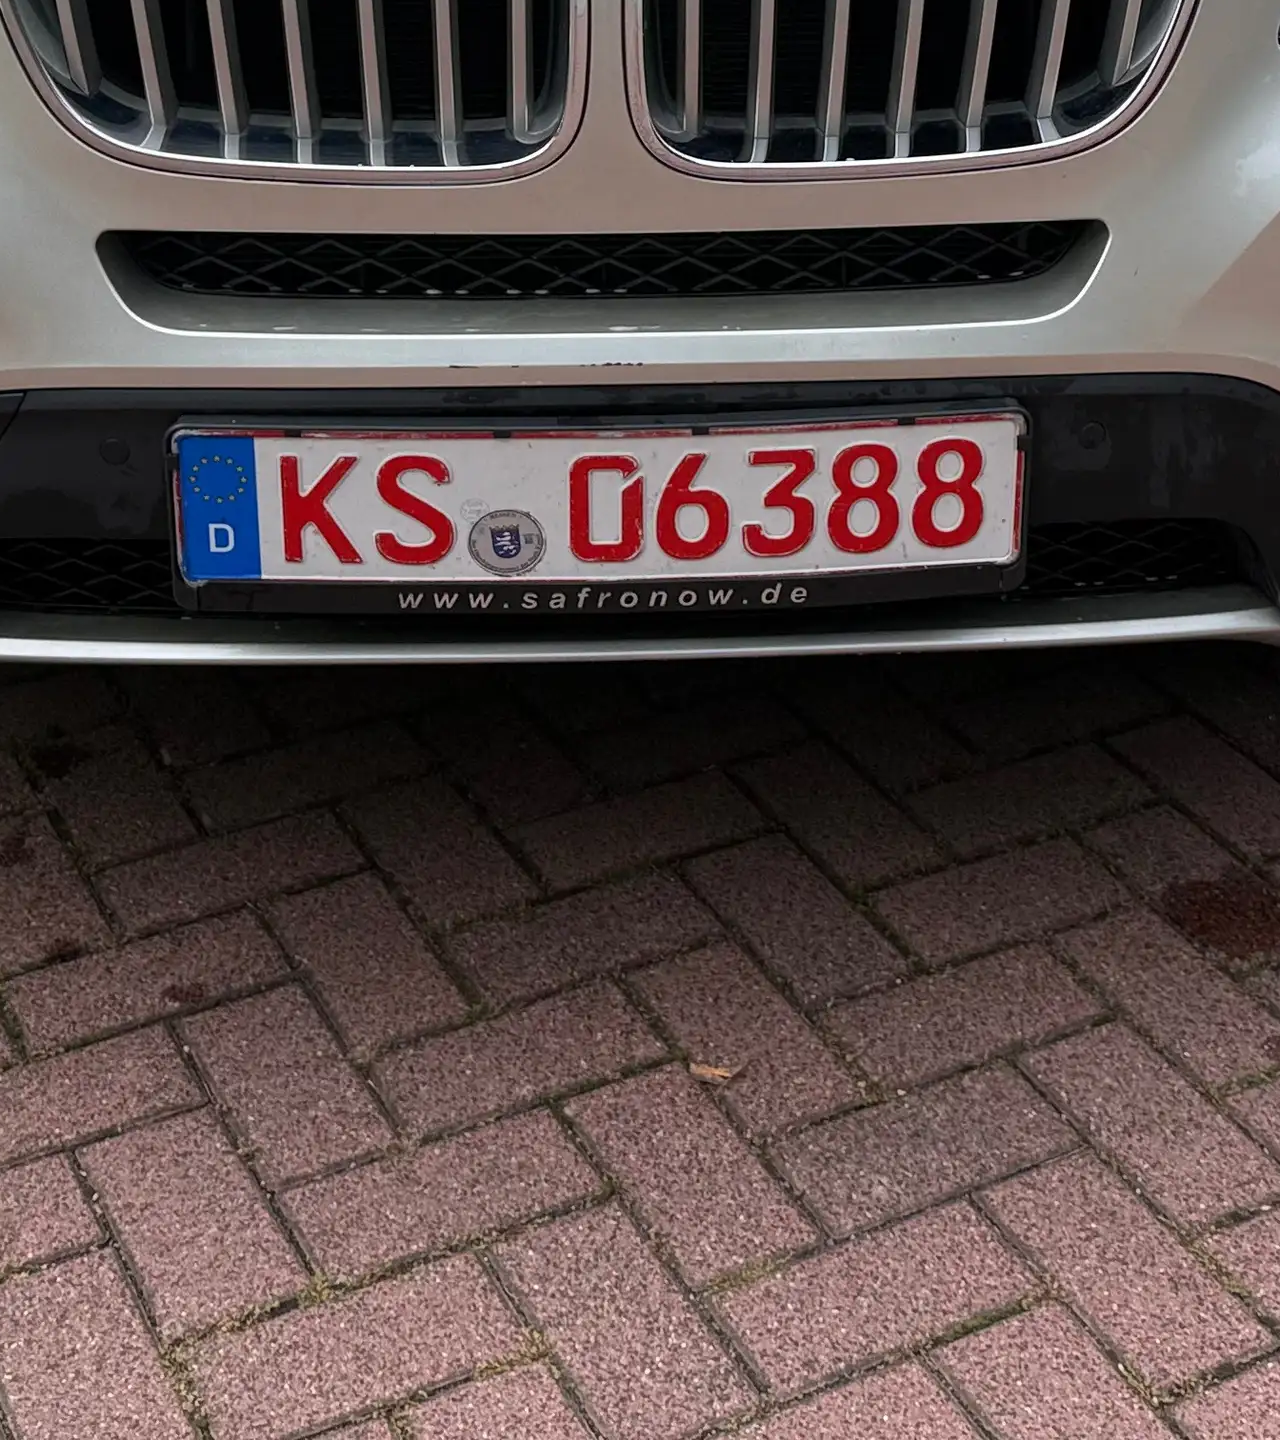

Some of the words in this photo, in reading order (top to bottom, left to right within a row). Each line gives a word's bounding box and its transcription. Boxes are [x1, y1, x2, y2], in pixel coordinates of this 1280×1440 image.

[278, 453, 456, 564] KS
[569, 437, 984, 562] 06388
[208, 523, 235, 553] D
[398, 582, 809, 609] www.safronow.de
